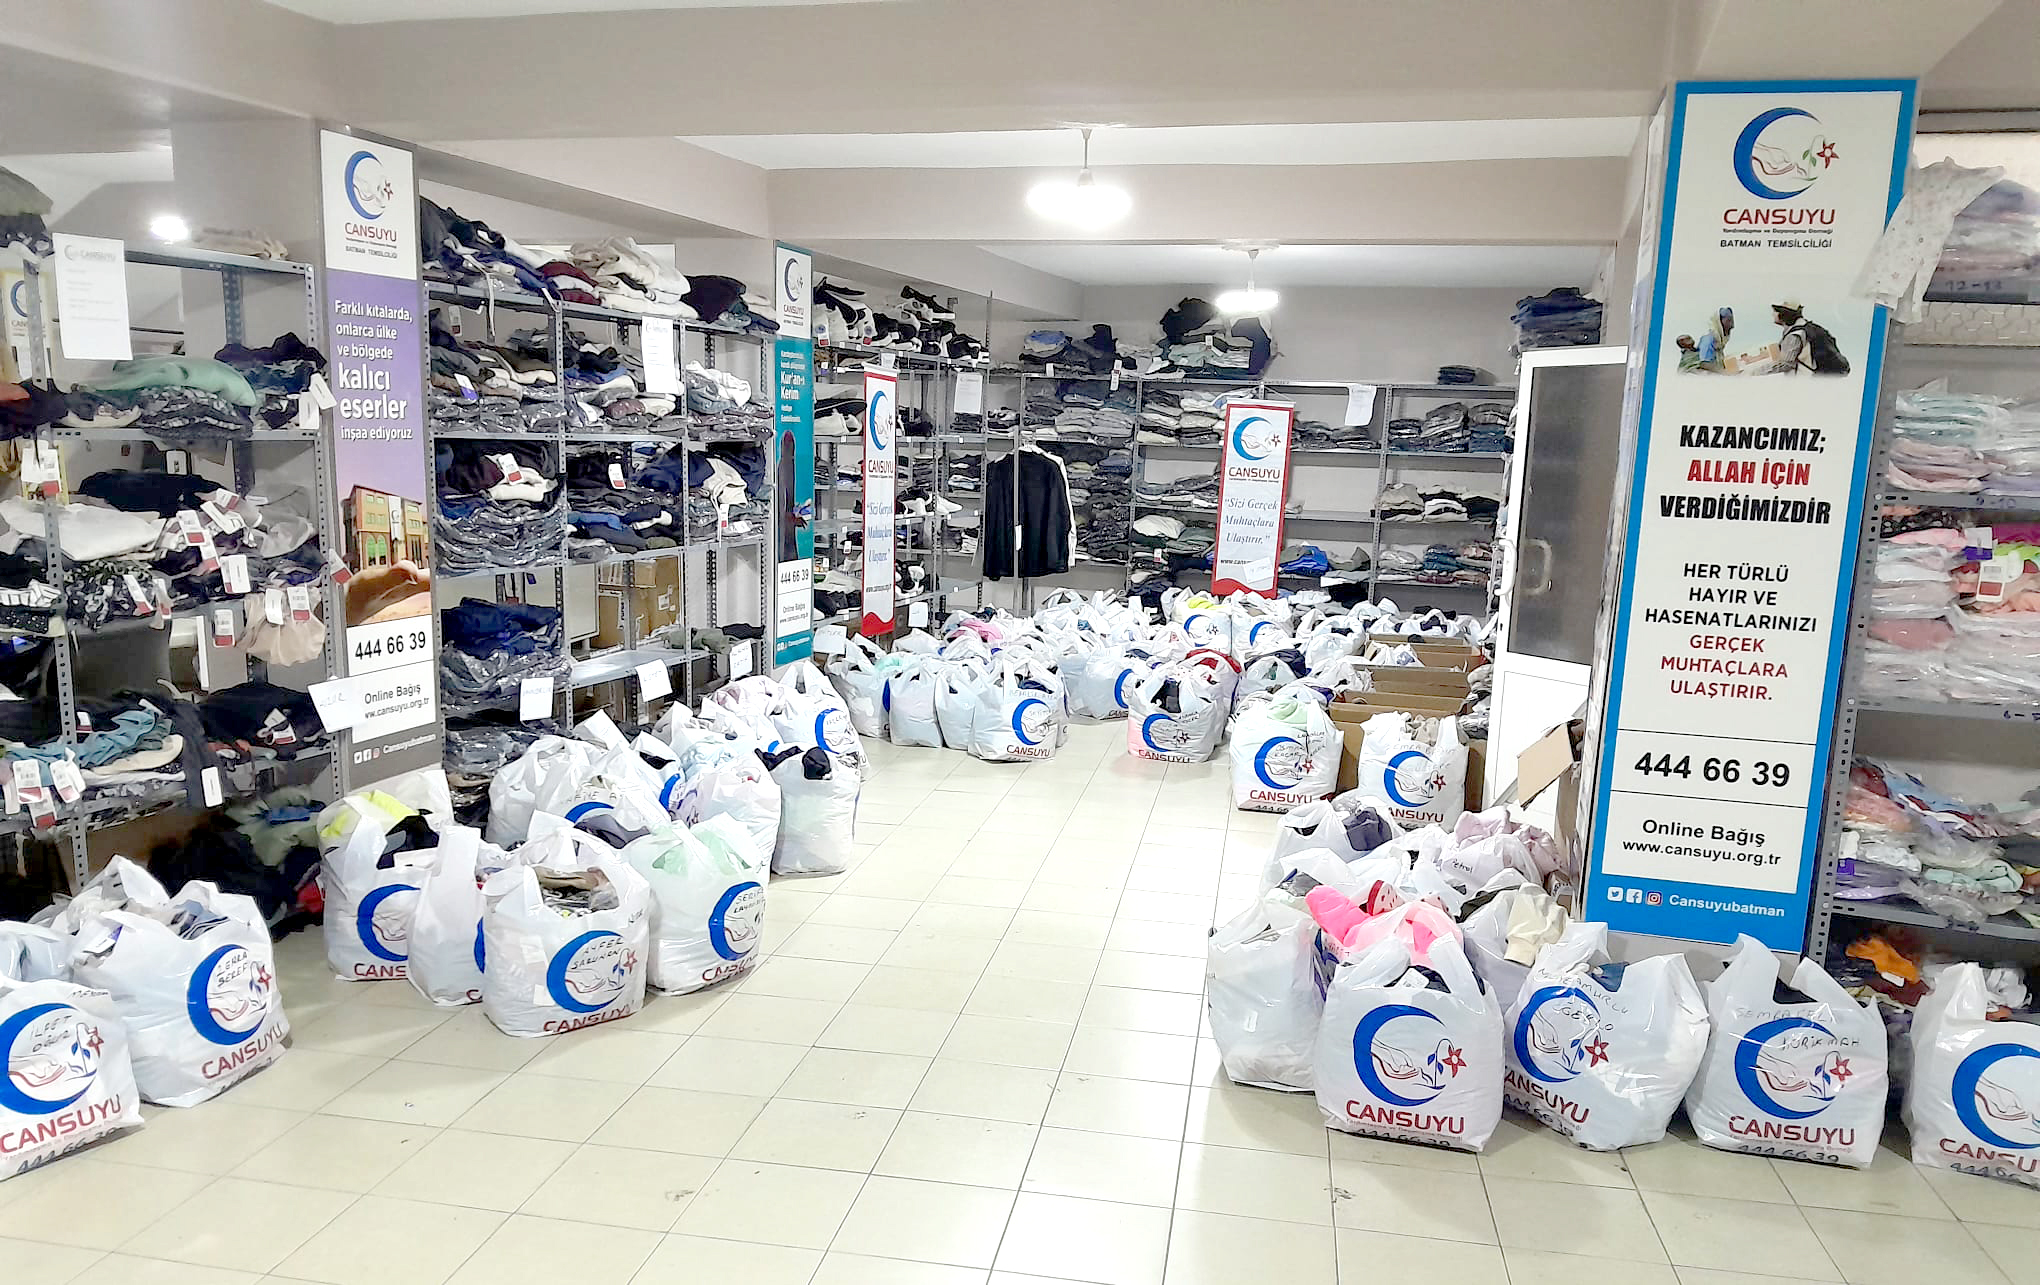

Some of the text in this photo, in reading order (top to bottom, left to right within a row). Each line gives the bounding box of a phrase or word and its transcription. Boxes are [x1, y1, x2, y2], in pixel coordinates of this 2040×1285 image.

[1723, 208, 1836, 225] CANSUYU
[344, 222, 397, 242] CANSUYU
[1719, 237, 1833, 249] BATMAN TEMSİLCİLİĞİ
[335, 300, 413, 323] Farklı kıtalarda,
[336, 323, 397, 340] onlarca ülke
[337, 344, 393, 361] ve bölgede
[338, 363, 391, 391] kalıcı
[339, 396, 407, 421] eserler
[369, 426, 413, 441] ediyoruz
[1679, 425, 1827, 454] KAZANCIMIZ;
[868, 459, 894, 474] CANSUYU
[1228, 466, 1281, 480] CANSUYU
[1687, 459, 1811, 490] ALLAH İÇİN
[1247, 498, 1278, 512] Gerçek
[1659, 492, 1831, 525] VERDİĞİMİZDİR
[1223, 514, 1275, 529] Muhtaçlara
[802, 568, 809, 581] 39
[1683, 563, 1789, 583] HER TÜRLÜ
[1688, 587, 1778, 606] HAYIR VE
[1644, 608, 1817, 633] HASENATLARINIZI
[355, 631, 426, 662] 444 66 39
[1690, 634, 1766, 656] GERÇEK
[1660, 655, 1788, 679] MUHTAÇLARA
[364, 683, 422, 705] Online Bağış
[1670, 680, 1774, 701] ULAŞTIRIR.
[1006, 744, 1051, 758] CANSUYU
[1138, 749, 1191, 764] CANSUYU
[1635, 752, 1791, 788] 444 66 39
[1249, 789, 1313, 804] CANSUYU
[1388, 807, 1444, 823] ANSUYU
[1642, 819, 1766, 847] Online Bağış
[1622, 839, 1782, 866] www.cansuyu.org.tr
[1669, 894, 1785, 917] Cansuyubatman
[354, 963, 407, 977] CANS
[201, 1022, 283, 1080] CANSUYU
[1503, 1070, 1591, 1124] ANSUYU
[0, 1094, 122, 1154] CANSUYU
[1345, 1099, 1465, 1134] CANSUYU
[1728, 1115, 1855, 1145] CANSUYU
[1939, 1138, 2038, 1172] CANSU
